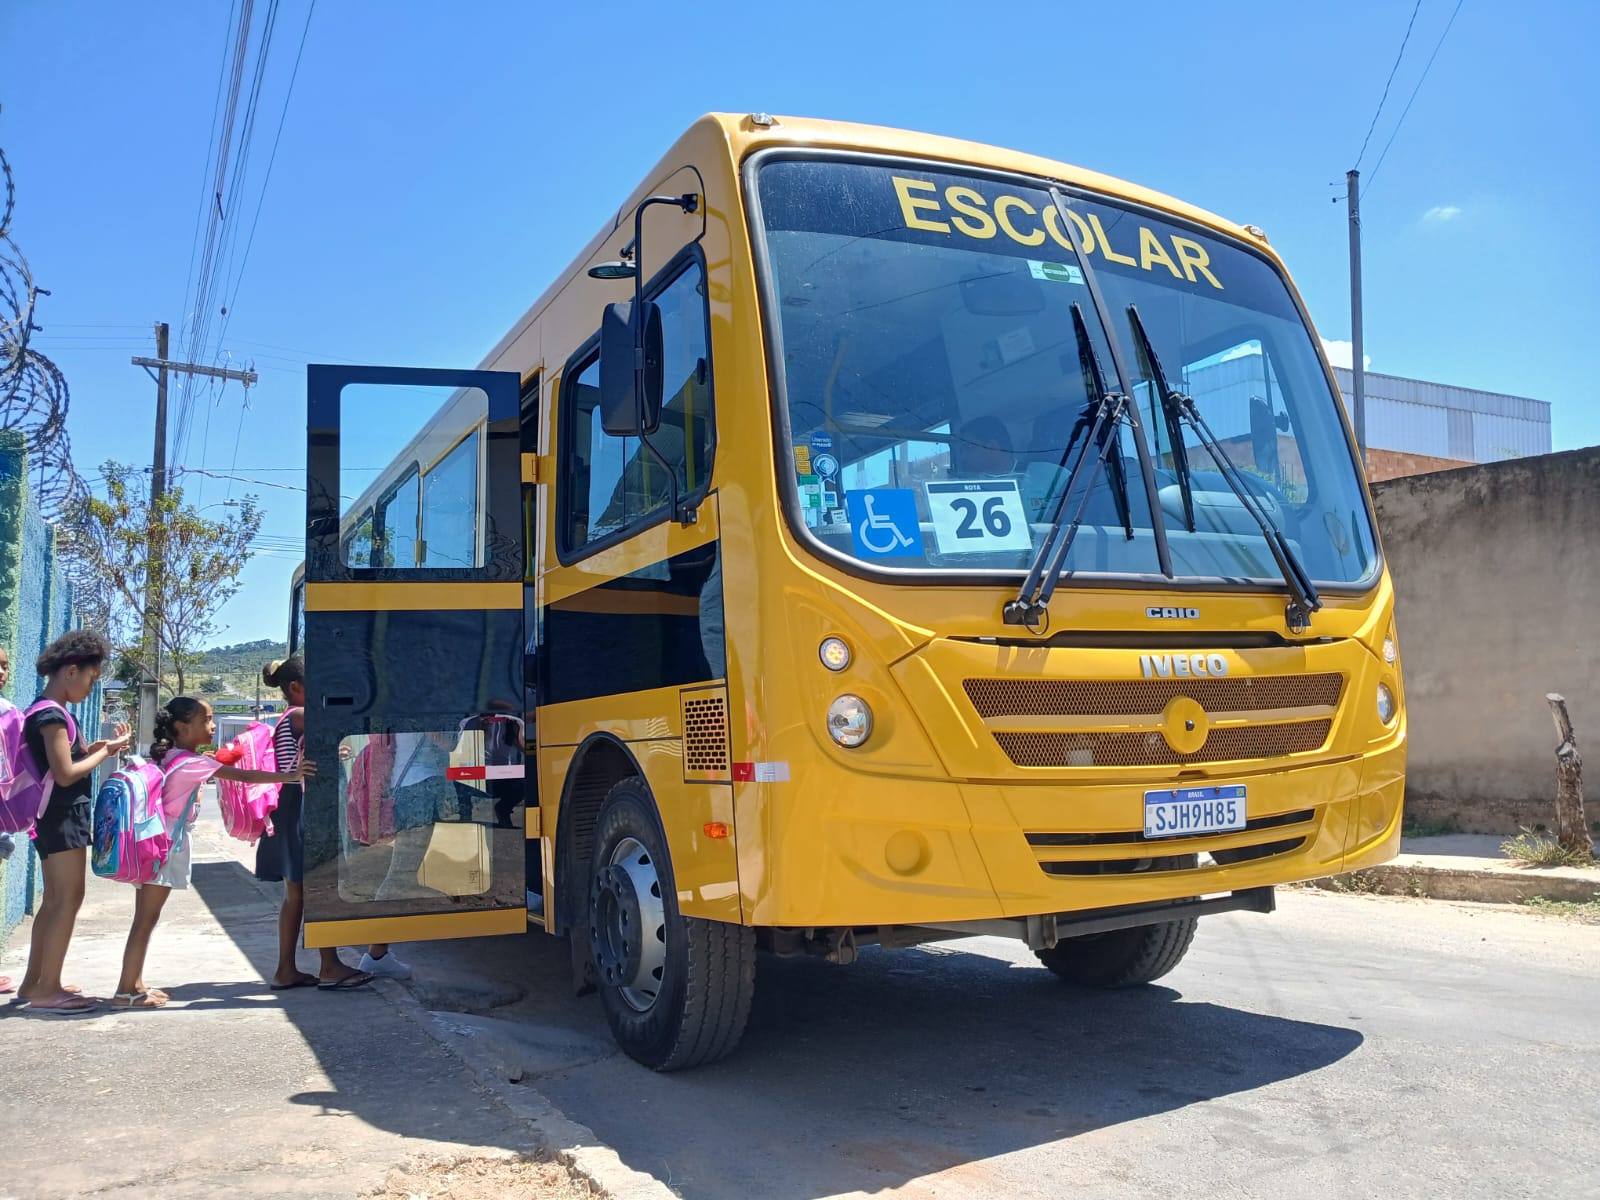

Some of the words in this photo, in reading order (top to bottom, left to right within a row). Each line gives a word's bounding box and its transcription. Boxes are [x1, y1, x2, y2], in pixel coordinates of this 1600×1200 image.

[892, 176, 1224, 289] ESCOLAR
[949, 496, 1012, 539] 26
[1145, 607, 1200, 618] CAIO
[1139, 653, 1229, 679] IVECO
[1155, 801, 1237, 831] SJH9H85
